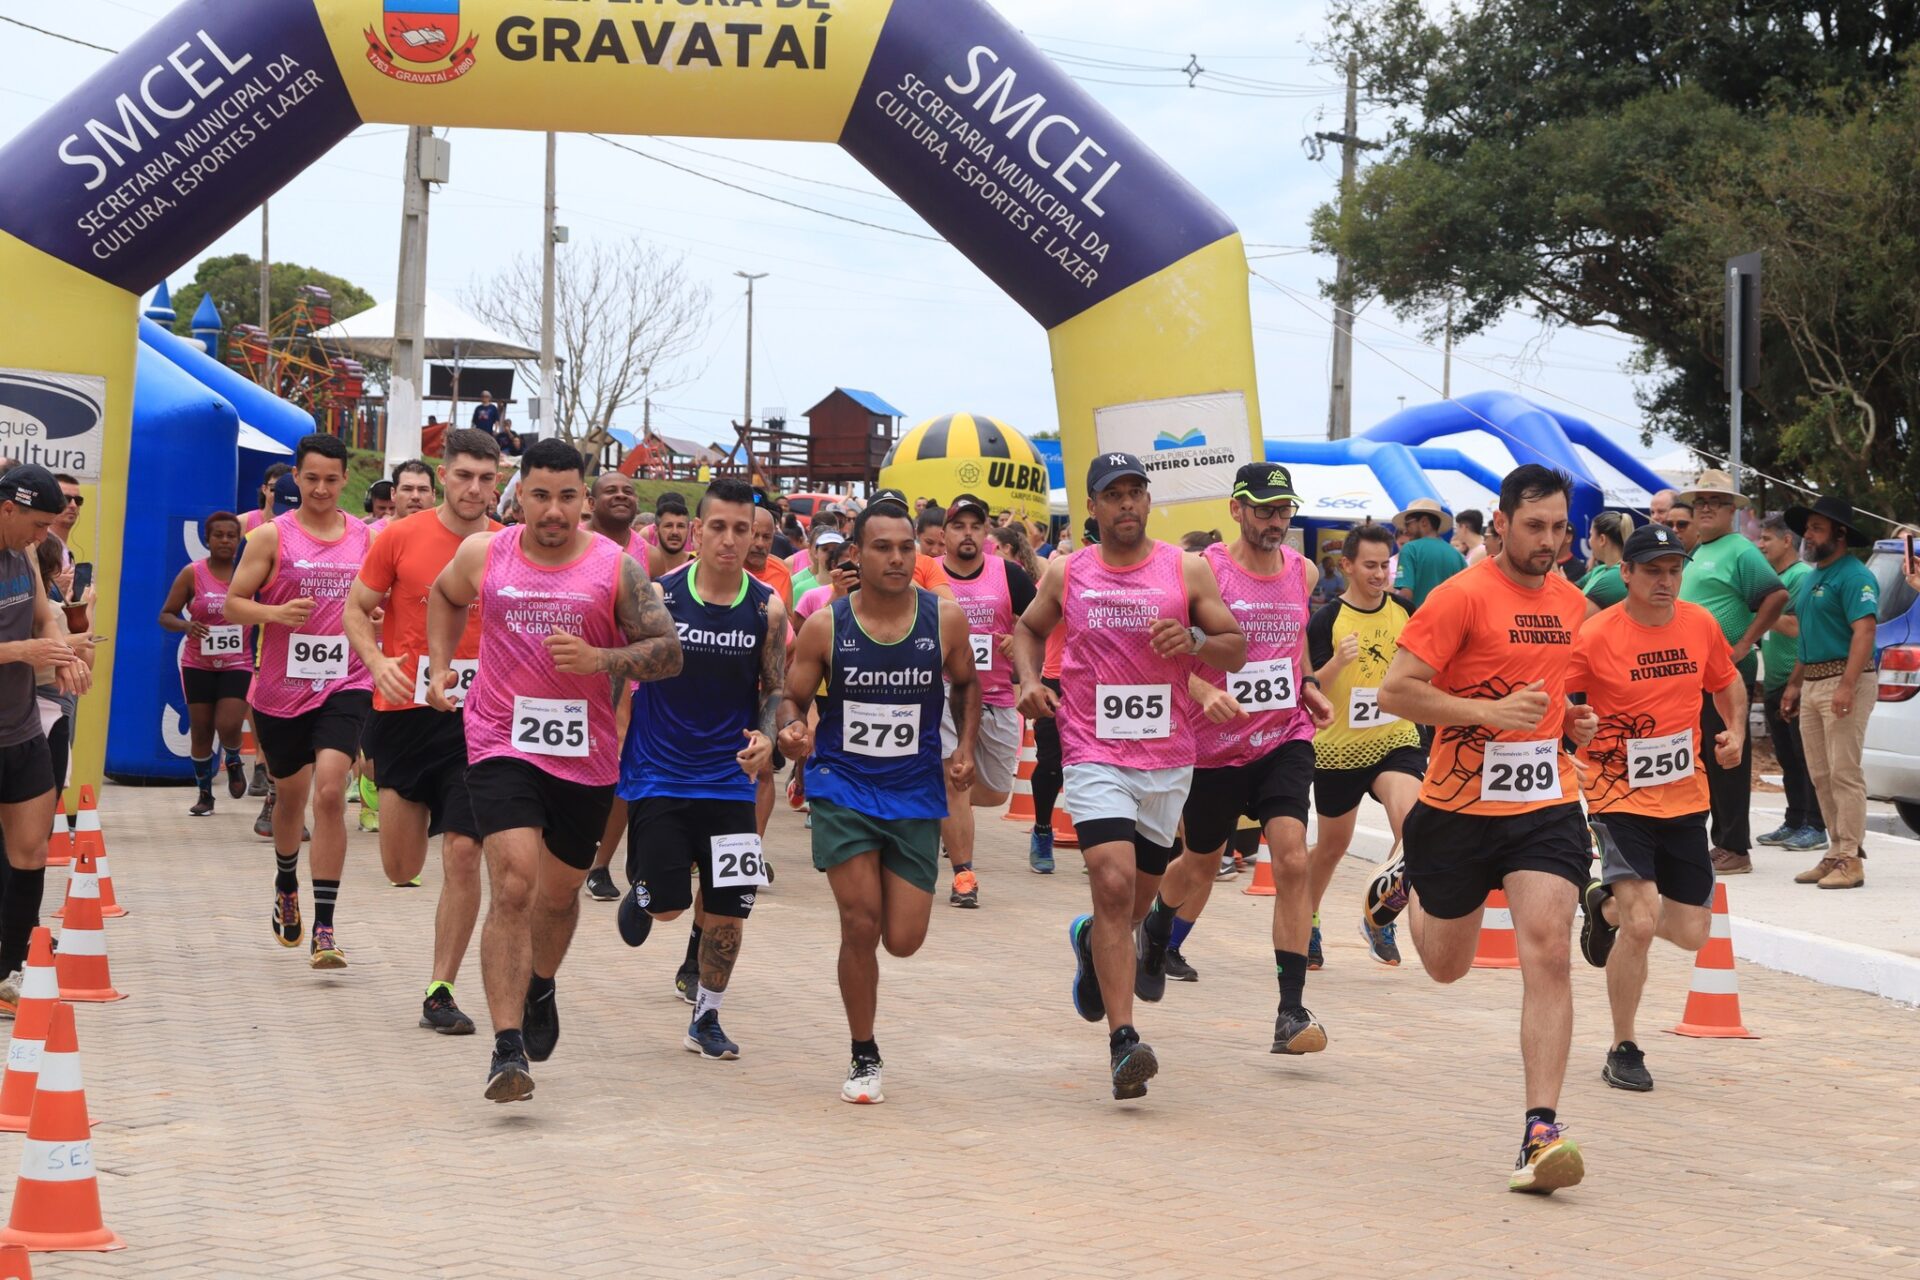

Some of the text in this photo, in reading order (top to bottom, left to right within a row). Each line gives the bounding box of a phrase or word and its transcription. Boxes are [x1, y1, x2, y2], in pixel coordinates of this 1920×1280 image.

[495, 13, 832, 70] GRAVATAÍ
[369, 53, 389, 73] 1763
[453, 57, 474, 76] 1880
[58, 29, 252, 190] SMCEL
[944, 45, 1122, 217] SMCEL
[77, 53, 300, 237] SECRETARIA MUNICIPAL DA
[92, 69, 324, 260] CULTURA, ESPORTES E LAZER
[897, 73, 1110, 263] SECRETARIA MUNICIPAL DA
[875, 90, 1099, 288] CULTURA, ESPORTES E LAZER
[0, 439, 85, 470] ultura
[1145, 454, 1235, 472] NTEIRO LOBATO
[300, 577, 351, 588] ANIVERSÁR
[315, 588, 349, 597] GRAVAT
[528, 602, 560, 610] CORRIDA
[1087, 604, 1159, 618] ANIVERSÁRIO
[507, 622, 522, 633] DE
[675, 622, 756, 648] Zanatta
[1088, 618, 1103, 629] DE
[205, 635, 240, 650] 156
[1508, 629, 1571, 645] RUNNERS
[294, 642, 343, 663] 964
[843, 667, 932, 686] Zanatta
[1629, 662, 1698, 681] RUNNERS
[1233, 677, 1291, 703] 283
[1104, 695, 1163, 719] 965
[518, 717, 584, 747] 265
[849, 721, 914, 748] 279
[1634, 748, 1690, 779] 250
[1488, 761, 1554, 792] 289
